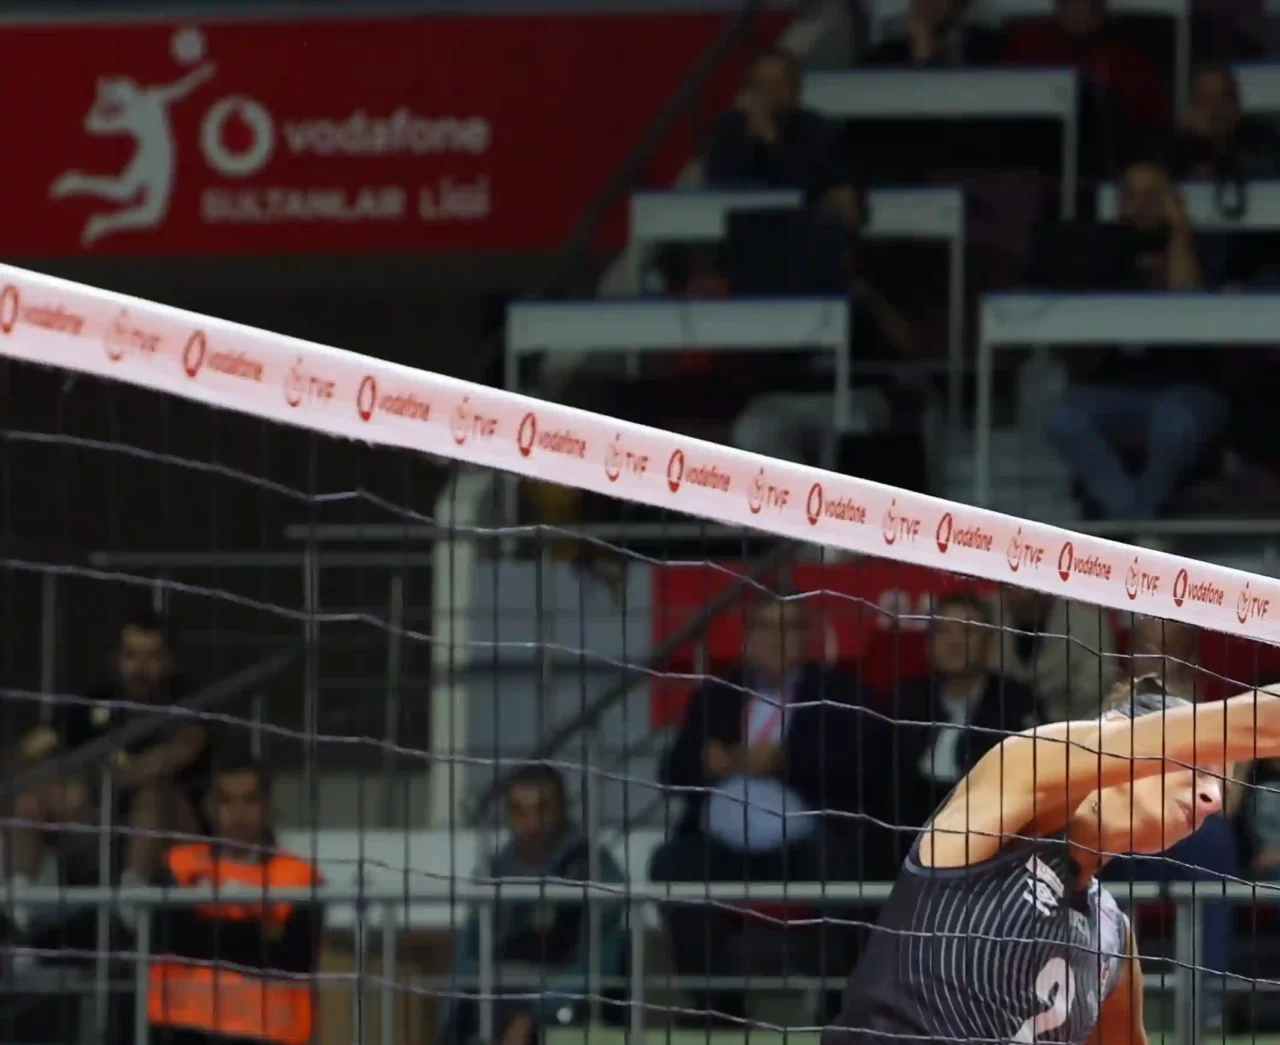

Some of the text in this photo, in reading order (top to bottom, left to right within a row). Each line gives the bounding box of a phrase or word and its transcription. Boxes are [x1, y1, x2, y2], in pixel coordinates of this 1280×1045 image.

[283, 107, 490, 155] vodafone
[686, 465, 731, 493] vodafone
[766, 486, 791, 511] TVF
[824, 498, 867, 525] vodafone
[899, 517, 921, 541] TVF
[952, 526, 994, 552] vodafone
[1023, 544, 1045, 569] TVF
[1073, 555, 1112, 581] vodafone
[1141, 575, 1161, 597] TVF
[1188, 580, 1225, 607] vodafone
[1250, 597, 1270, 621] TVF
